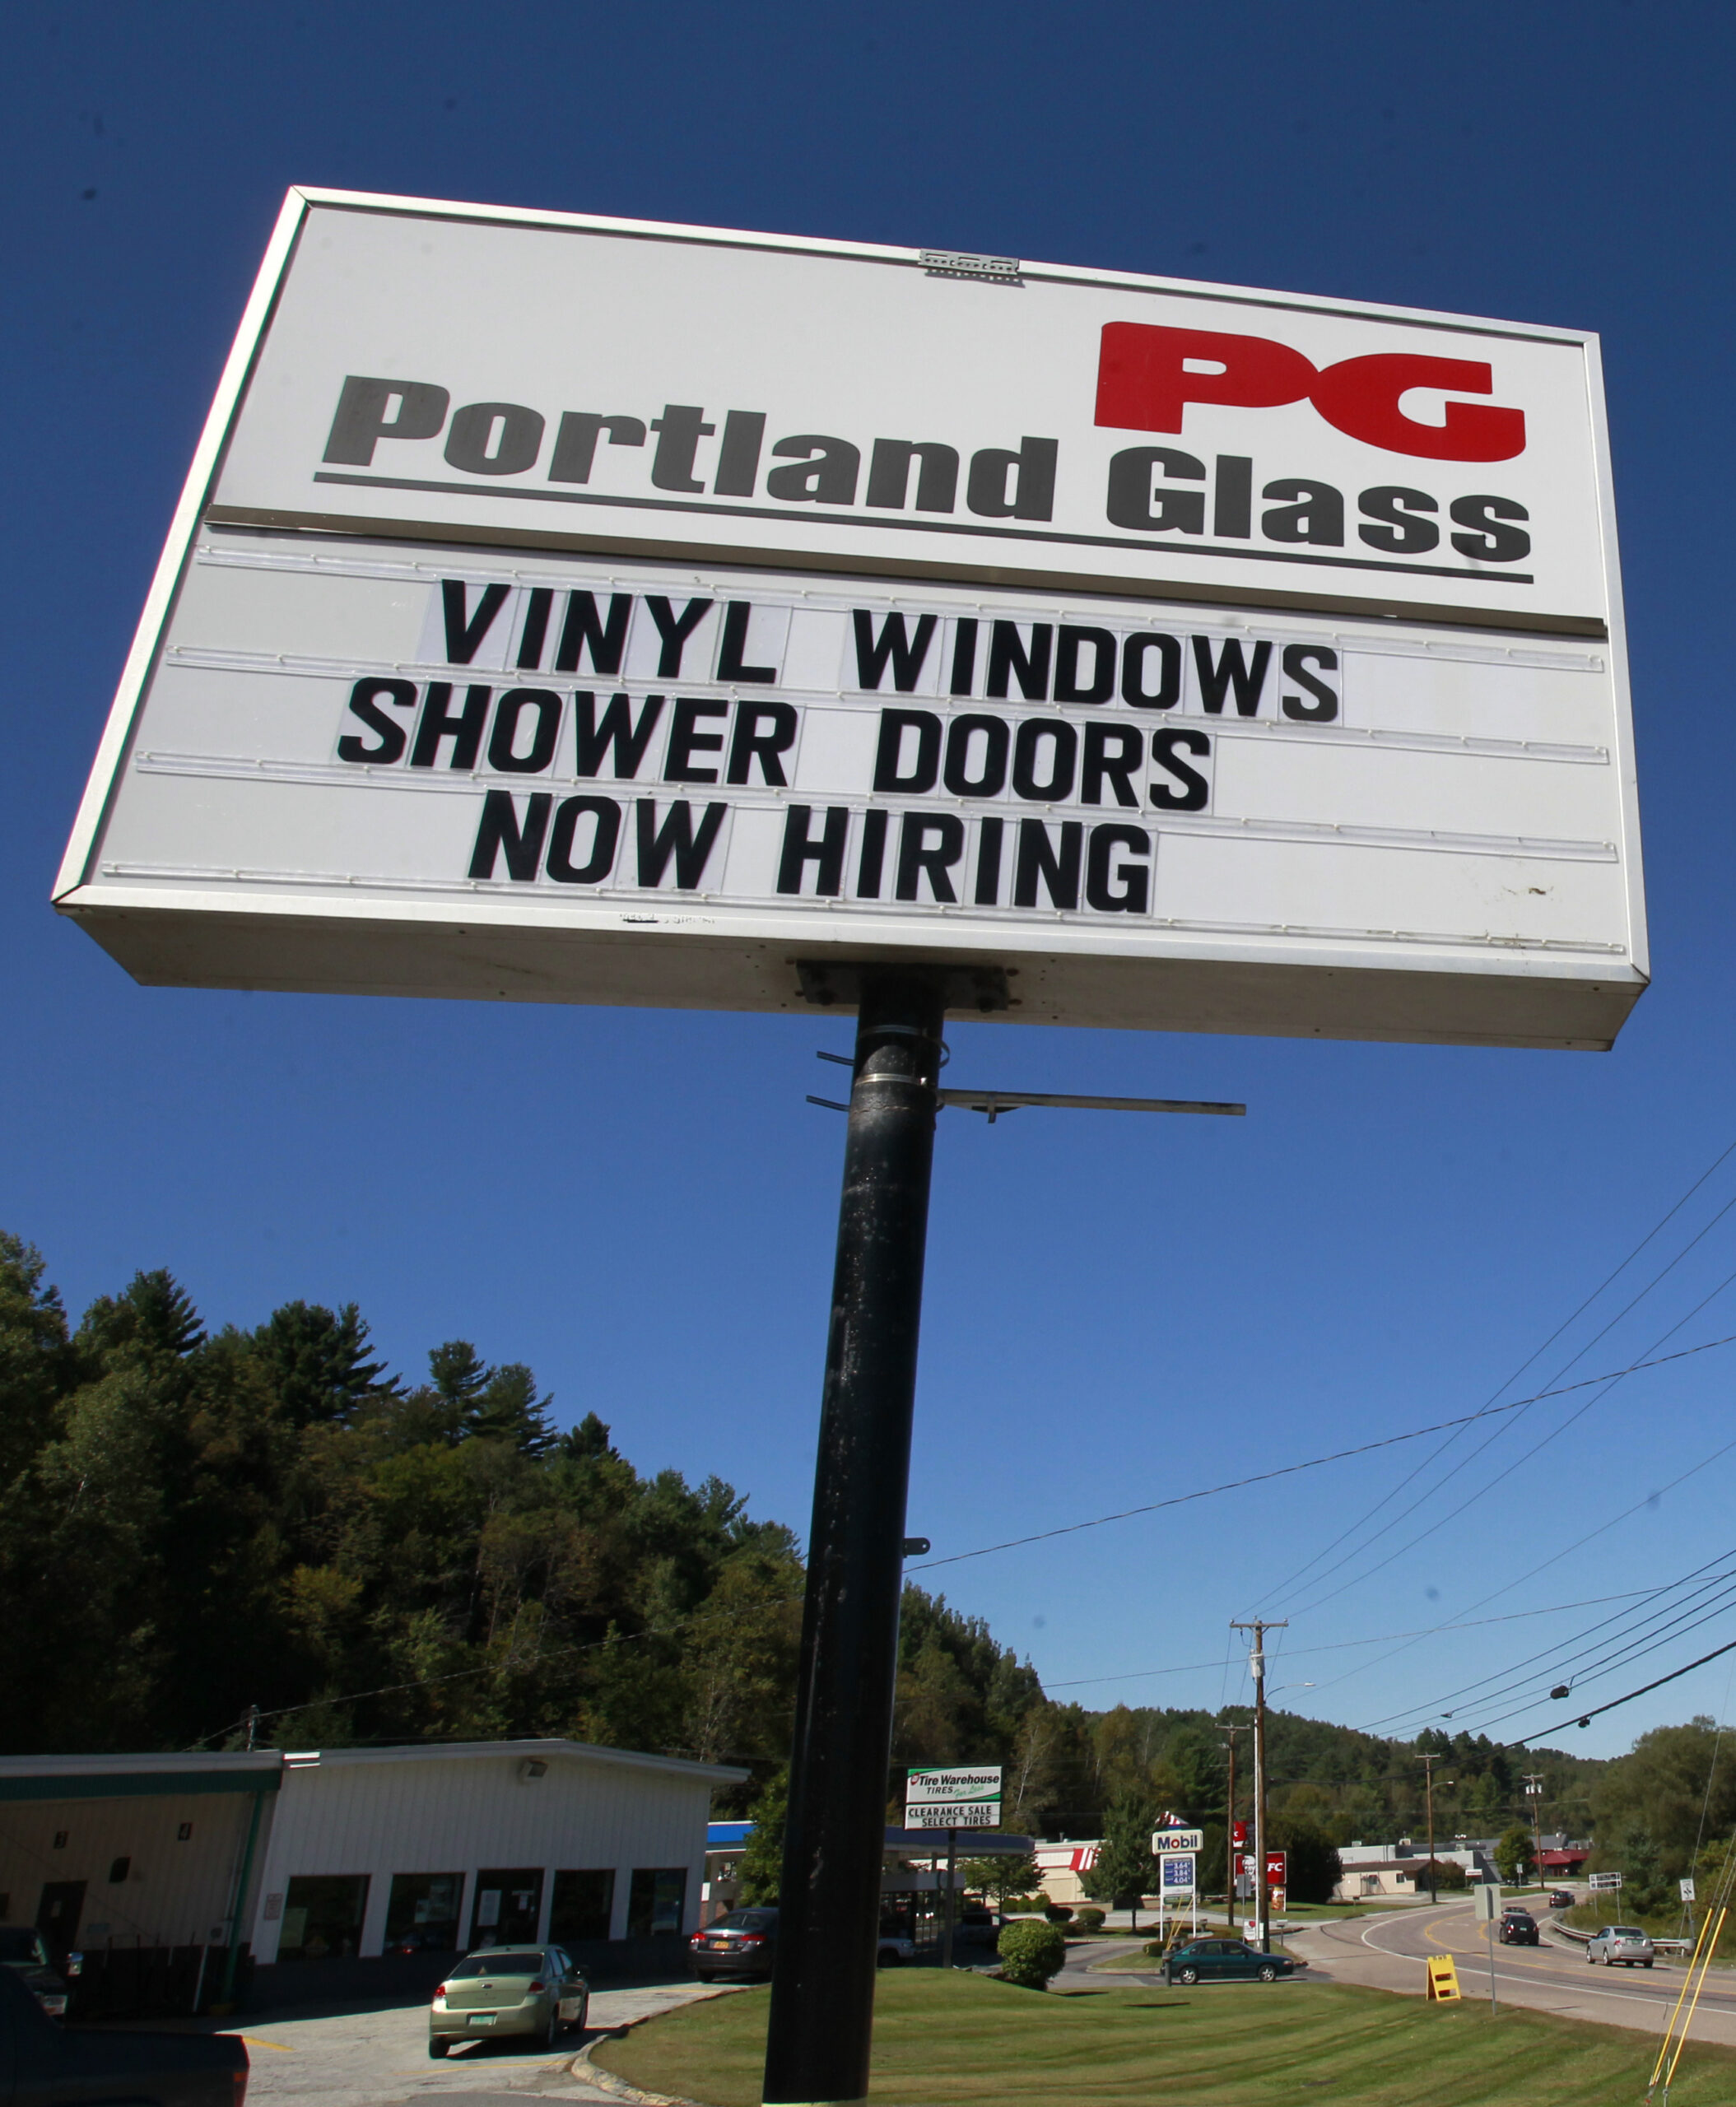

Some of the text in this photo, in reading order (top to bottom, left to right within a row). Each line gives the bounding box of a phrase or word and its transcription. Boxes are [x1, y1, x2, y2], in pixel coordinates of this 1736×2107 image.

[1094, 321, 1526, 463] PG
[322, 375, 1531, 563] Portland Glass
[441, 579, 1338, 723] VINYL WINDOWS
[337, 677, 1211, 812] SHOWER DOORS
[468, 788, 1152, 914] NOW HIRING
[908, 1806, 992, 1817] CLEARANCE SALE
[919, 1774, 999, 1786] Tire Warehouse
[927, 1786, 953, 1794] TIRES
[922, 1816, 991, 1827] SELECT TIRES
[1157, 1835, 1198, 1850] Mobil
